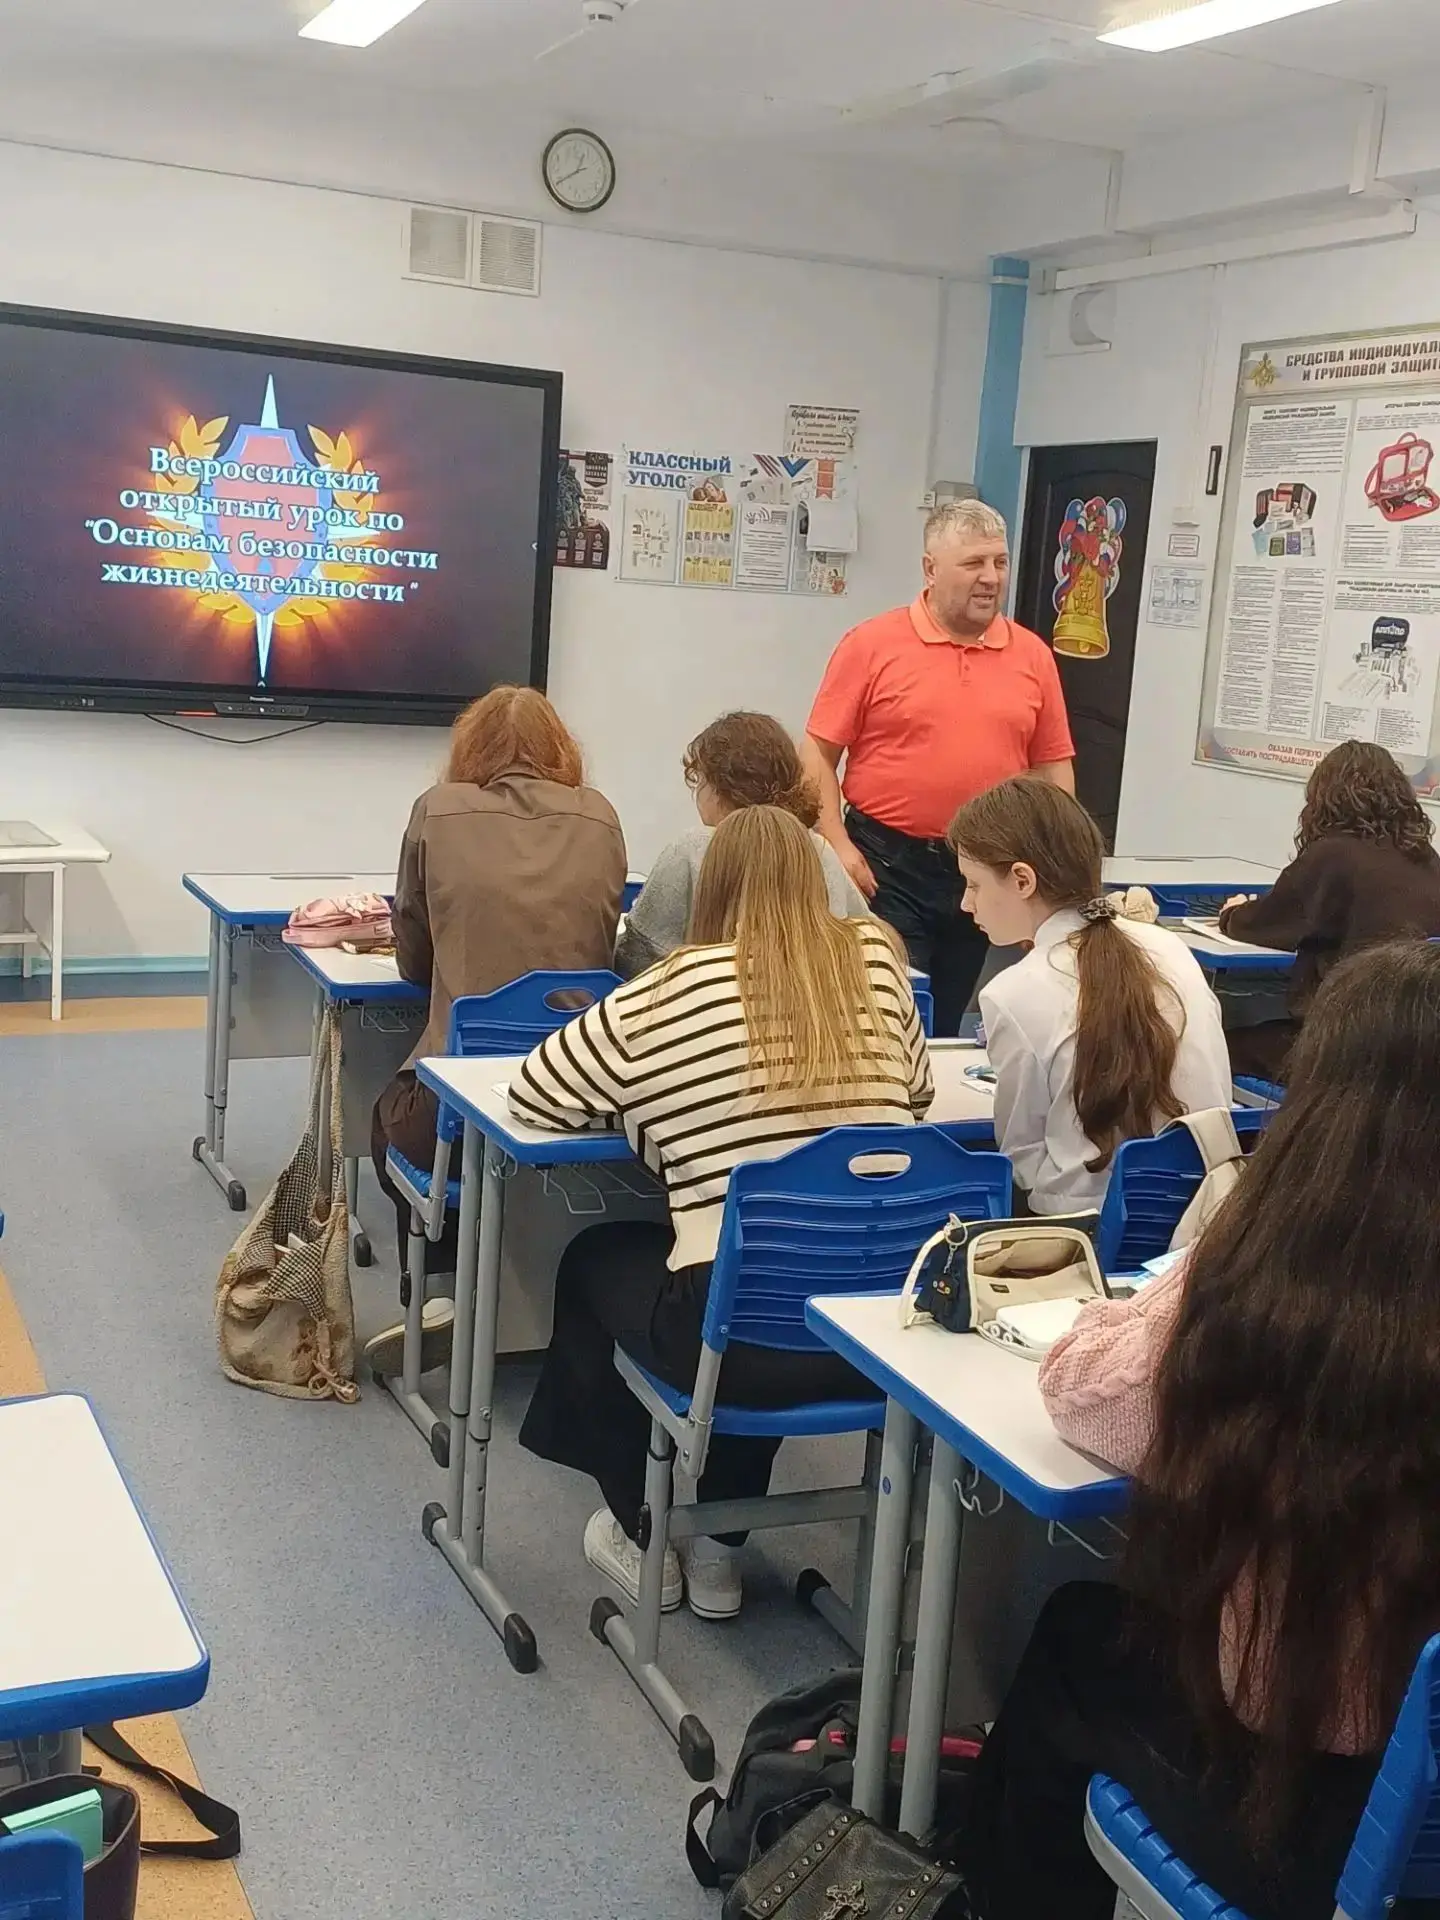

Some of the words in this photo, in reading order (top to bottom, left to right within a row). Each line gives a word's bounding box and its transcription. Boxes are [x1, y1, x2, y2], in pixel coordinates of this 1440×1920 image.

[1286, 349, 1344, 367] СРЕДСТВА
[1302, 369, 1311, 381] И
[1315, 362, 1386, 380] ГРУППОВОЙ
[149, 446, 380, 494] Всероссийский
[628, 450, 732, 474] КЛАССНЫЙ
[628, 470, 692, 489] УГОЛО
[119, 489, 282, 521] открытый
[287, 502, 361, 532] урок
[367, 510, 404, 532] по
[238, 531, 438, 570] безопасности
[100, 562, 405, 602] жизнедеятельности
